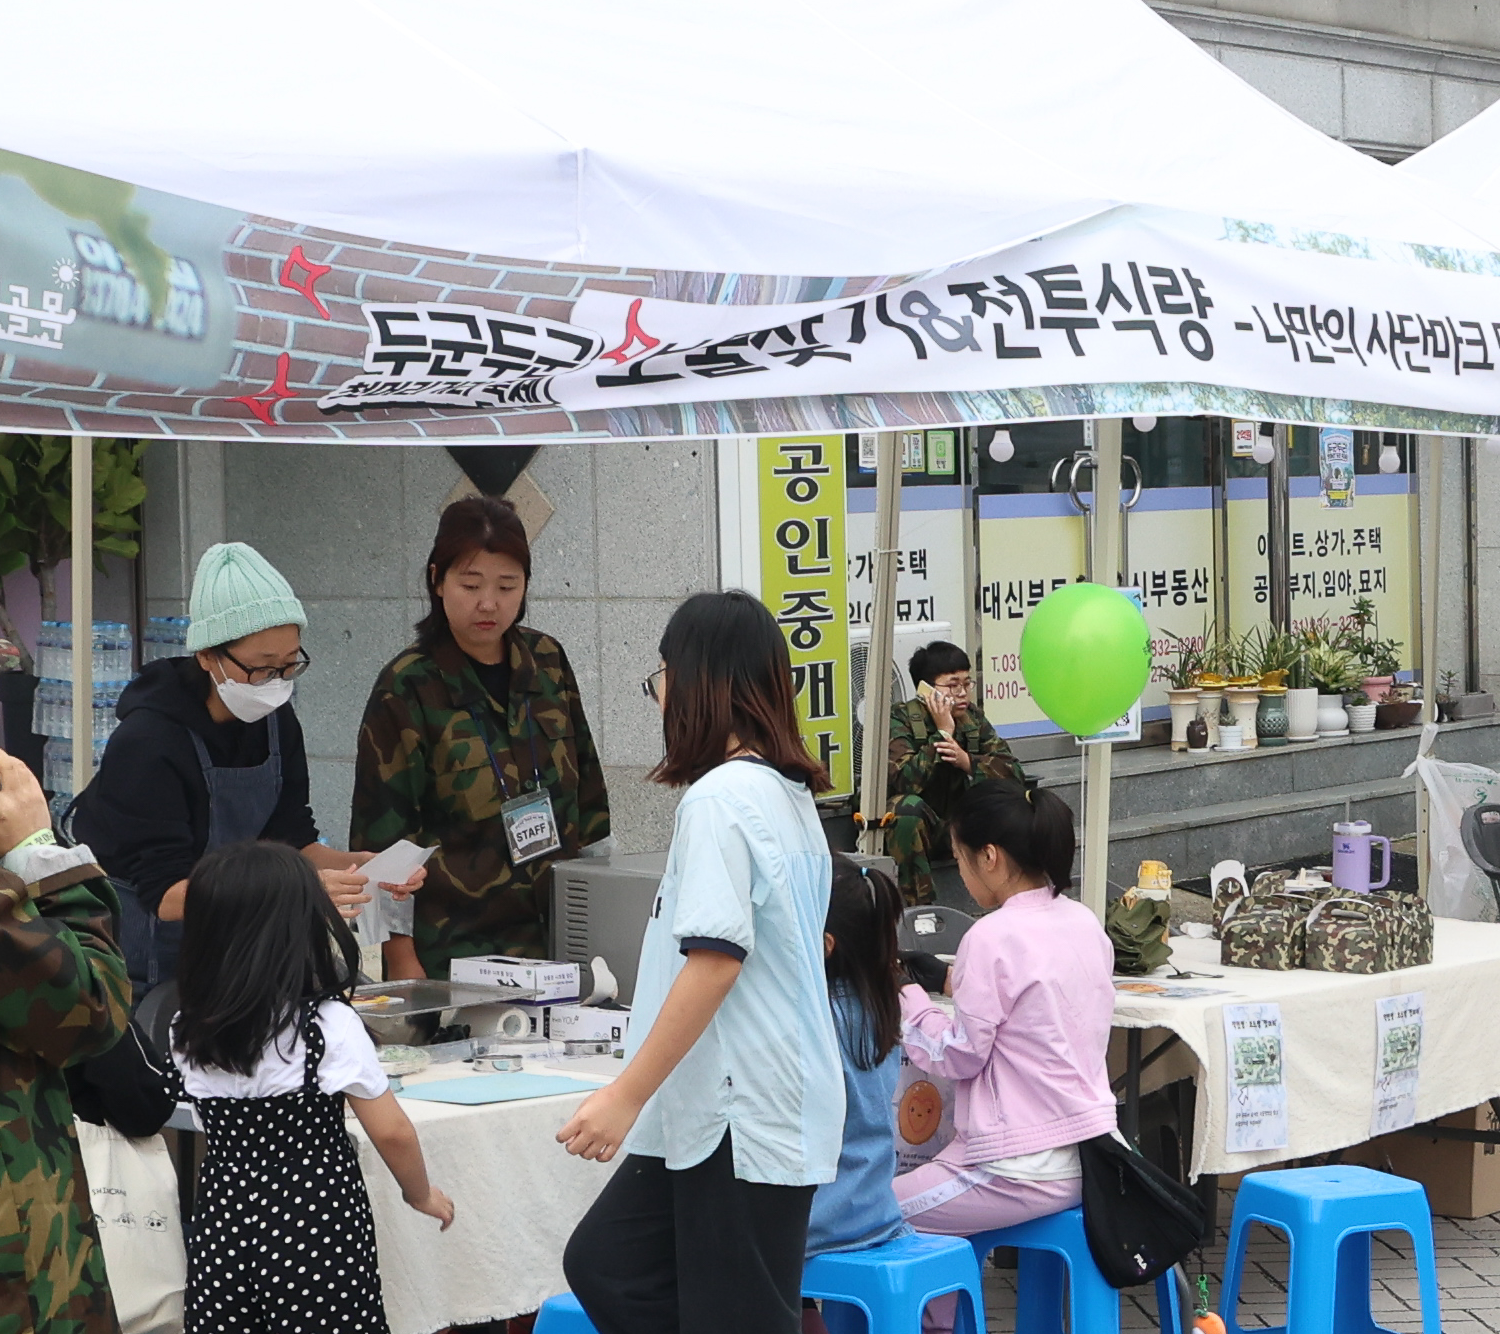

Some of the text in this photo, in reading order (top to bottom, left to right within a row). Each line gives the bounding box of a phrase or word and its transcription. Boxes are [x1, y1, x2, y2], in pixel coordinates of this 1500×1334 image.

[371, 310, 595, 379] 두군두군
[1366, 307, 1492, 376] 사단마크
[1257, 526, 1383, 561] 트.상가.주택
[1253, 565, 1389, 604] 공부지.임야.묘지
[515, 823, 547, 843] STAFF
